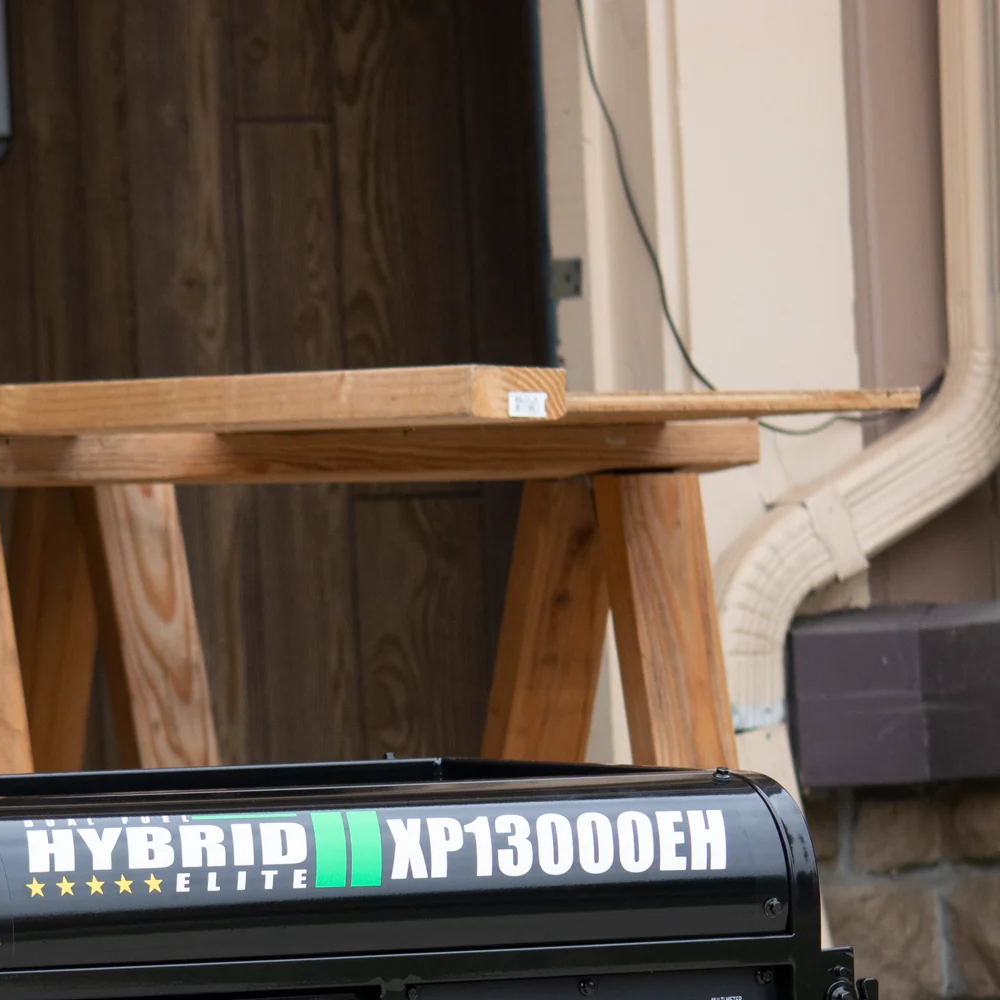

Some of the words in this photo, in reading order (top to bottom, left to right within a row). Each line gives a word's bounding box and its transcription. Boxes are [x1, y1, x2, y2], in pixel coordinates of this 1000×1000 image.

[26, 822, 307, 873] HYBRID
[386, 809, 727, 879] XP13000EH
[176, 869, 307, 892] ELITE
